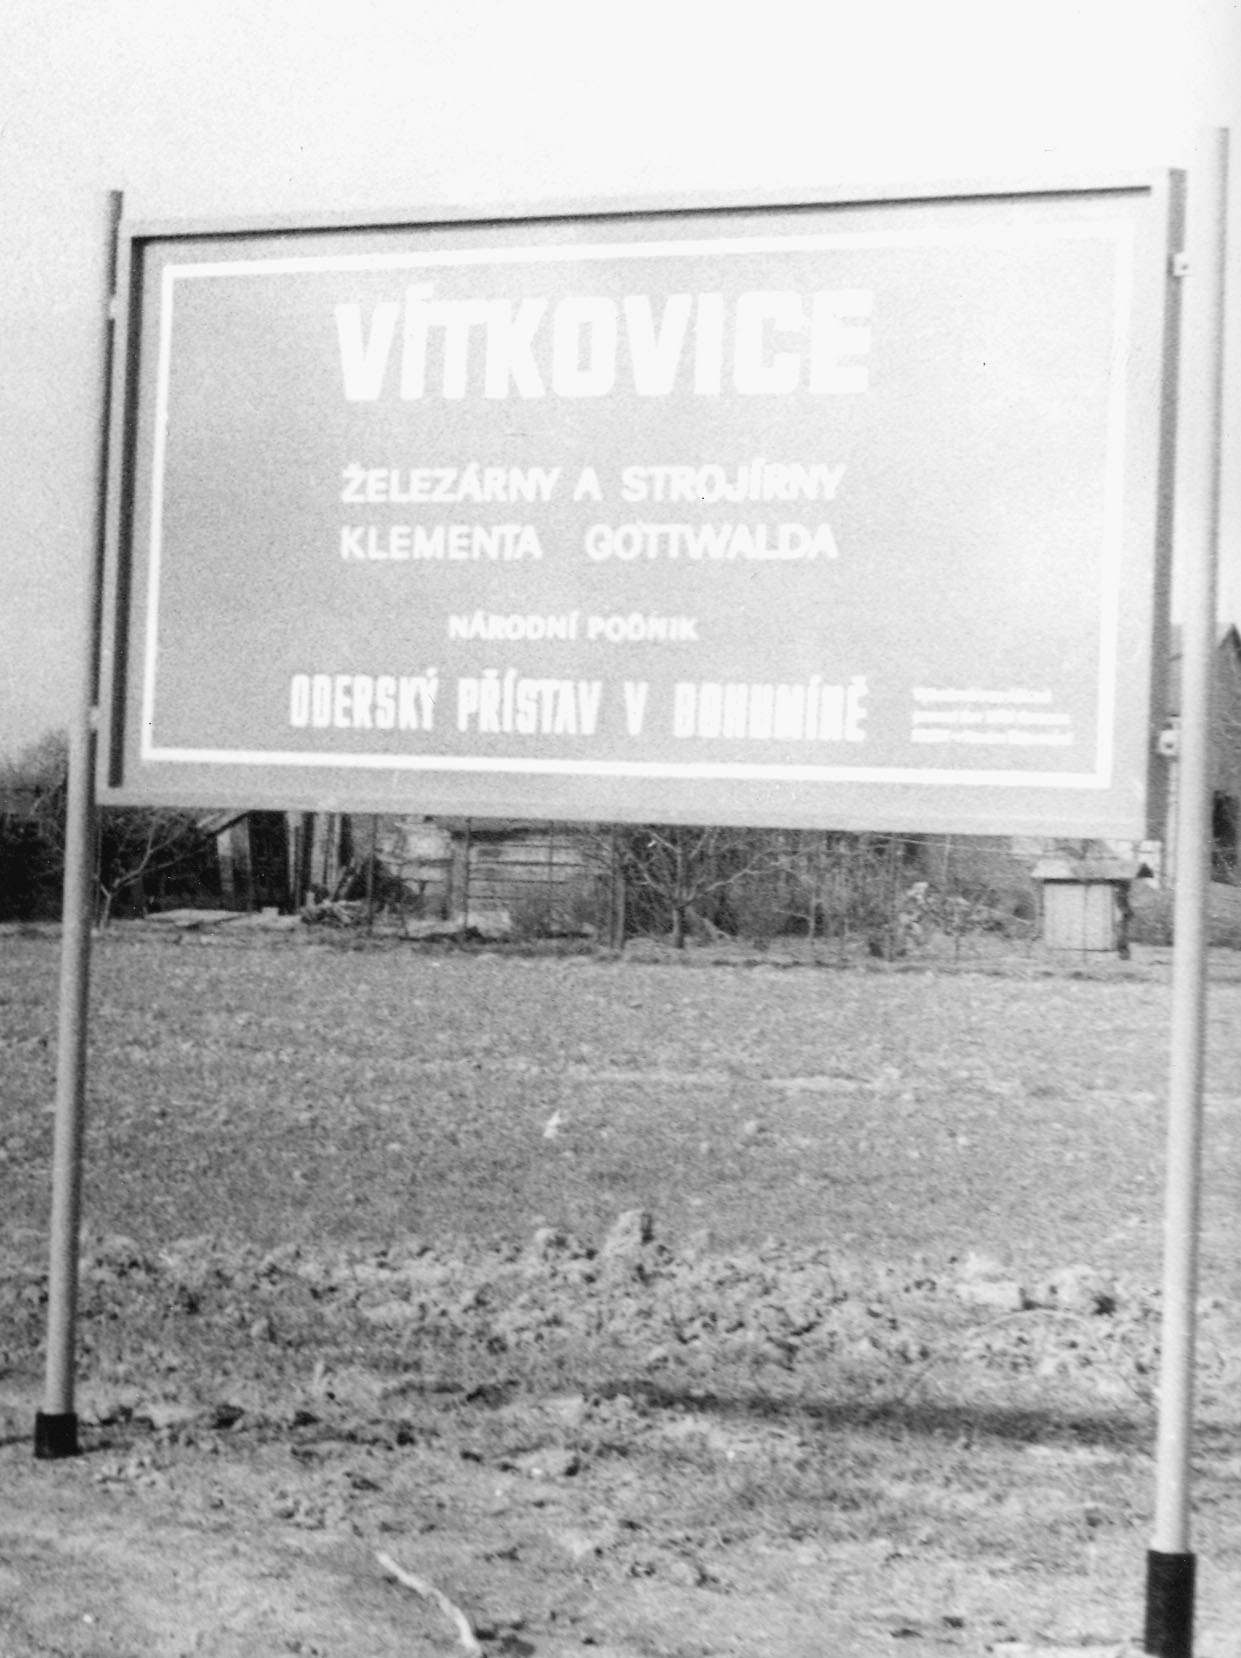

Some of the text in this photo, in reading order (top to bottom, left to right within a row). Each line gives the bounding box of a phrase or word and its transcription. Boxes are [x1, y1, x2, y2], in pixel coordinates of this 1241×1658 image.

[333, 282, 874, 402] VÍTKOVICE
[341, 459, 848, 504] ŽELEZÁRNY A STROJÍRNY
[340, 520, 839, 561] KLEMENTA GOTTWALDA
[448, 609, 699, 642] NÁRODNÍ PODNIK
[290, 666, 440, 731] ODERSKÝ
[457, 667, 603, 735] PŘÍSTAV
[623, 681, 649, 736] V
